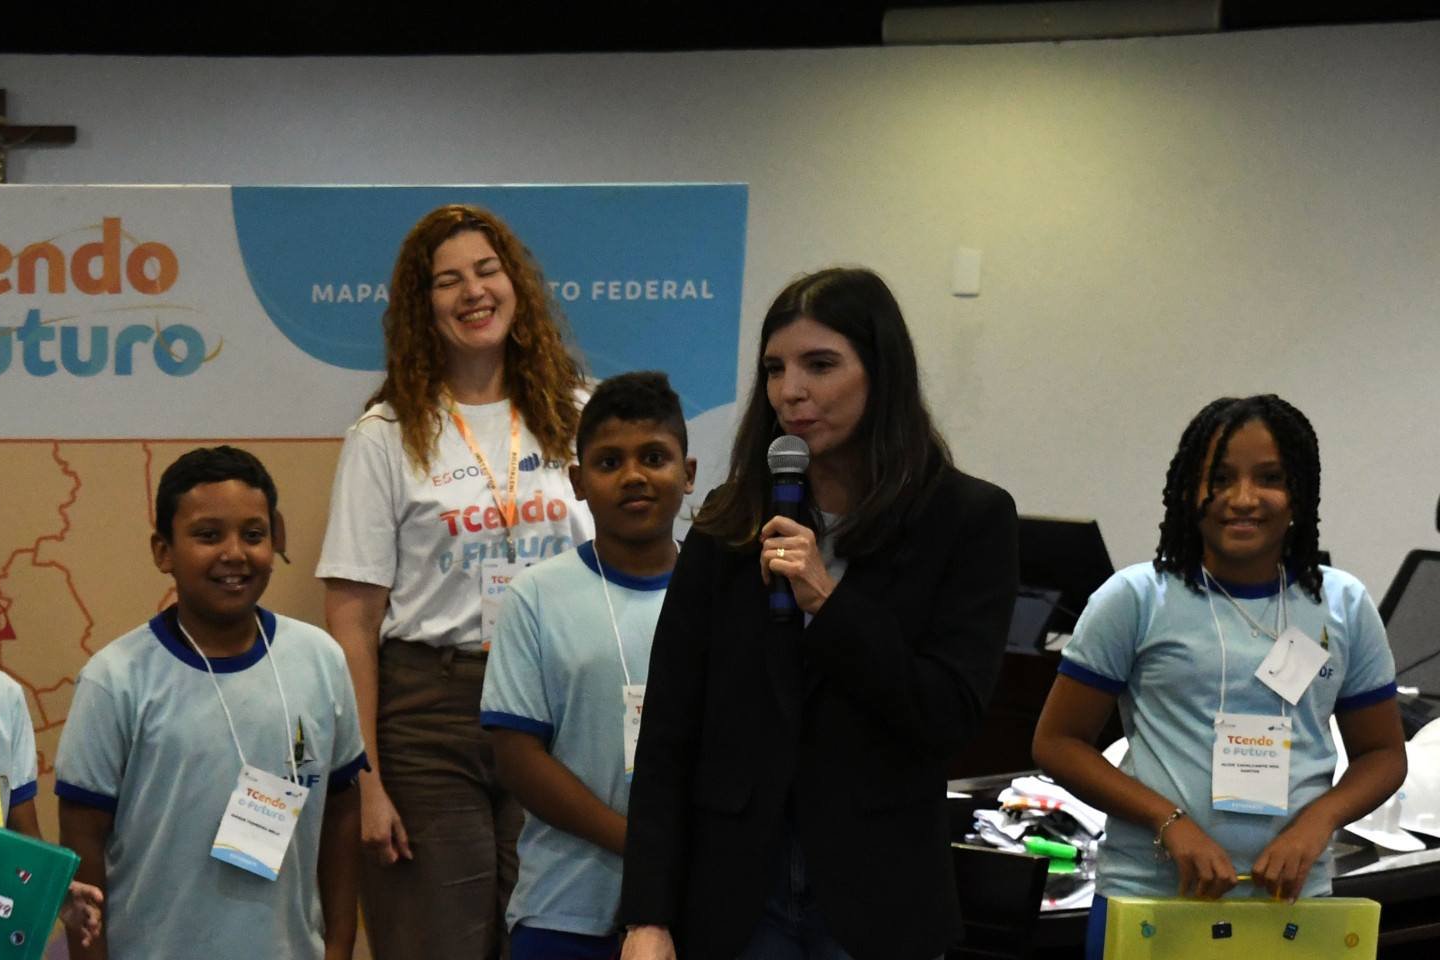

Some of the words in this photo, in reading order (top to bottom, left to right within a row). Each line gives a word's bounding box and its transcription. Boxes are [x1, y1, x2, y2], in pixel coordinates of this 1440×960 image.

[311, 283, 390, 303] MAPA
[591, 279, 714, 301] FEDERAL
[431, 464, 484, 488] ESCO
[1227, 735, 1274, 747] TCendo
[246, 787, 288, 811] TCendo
